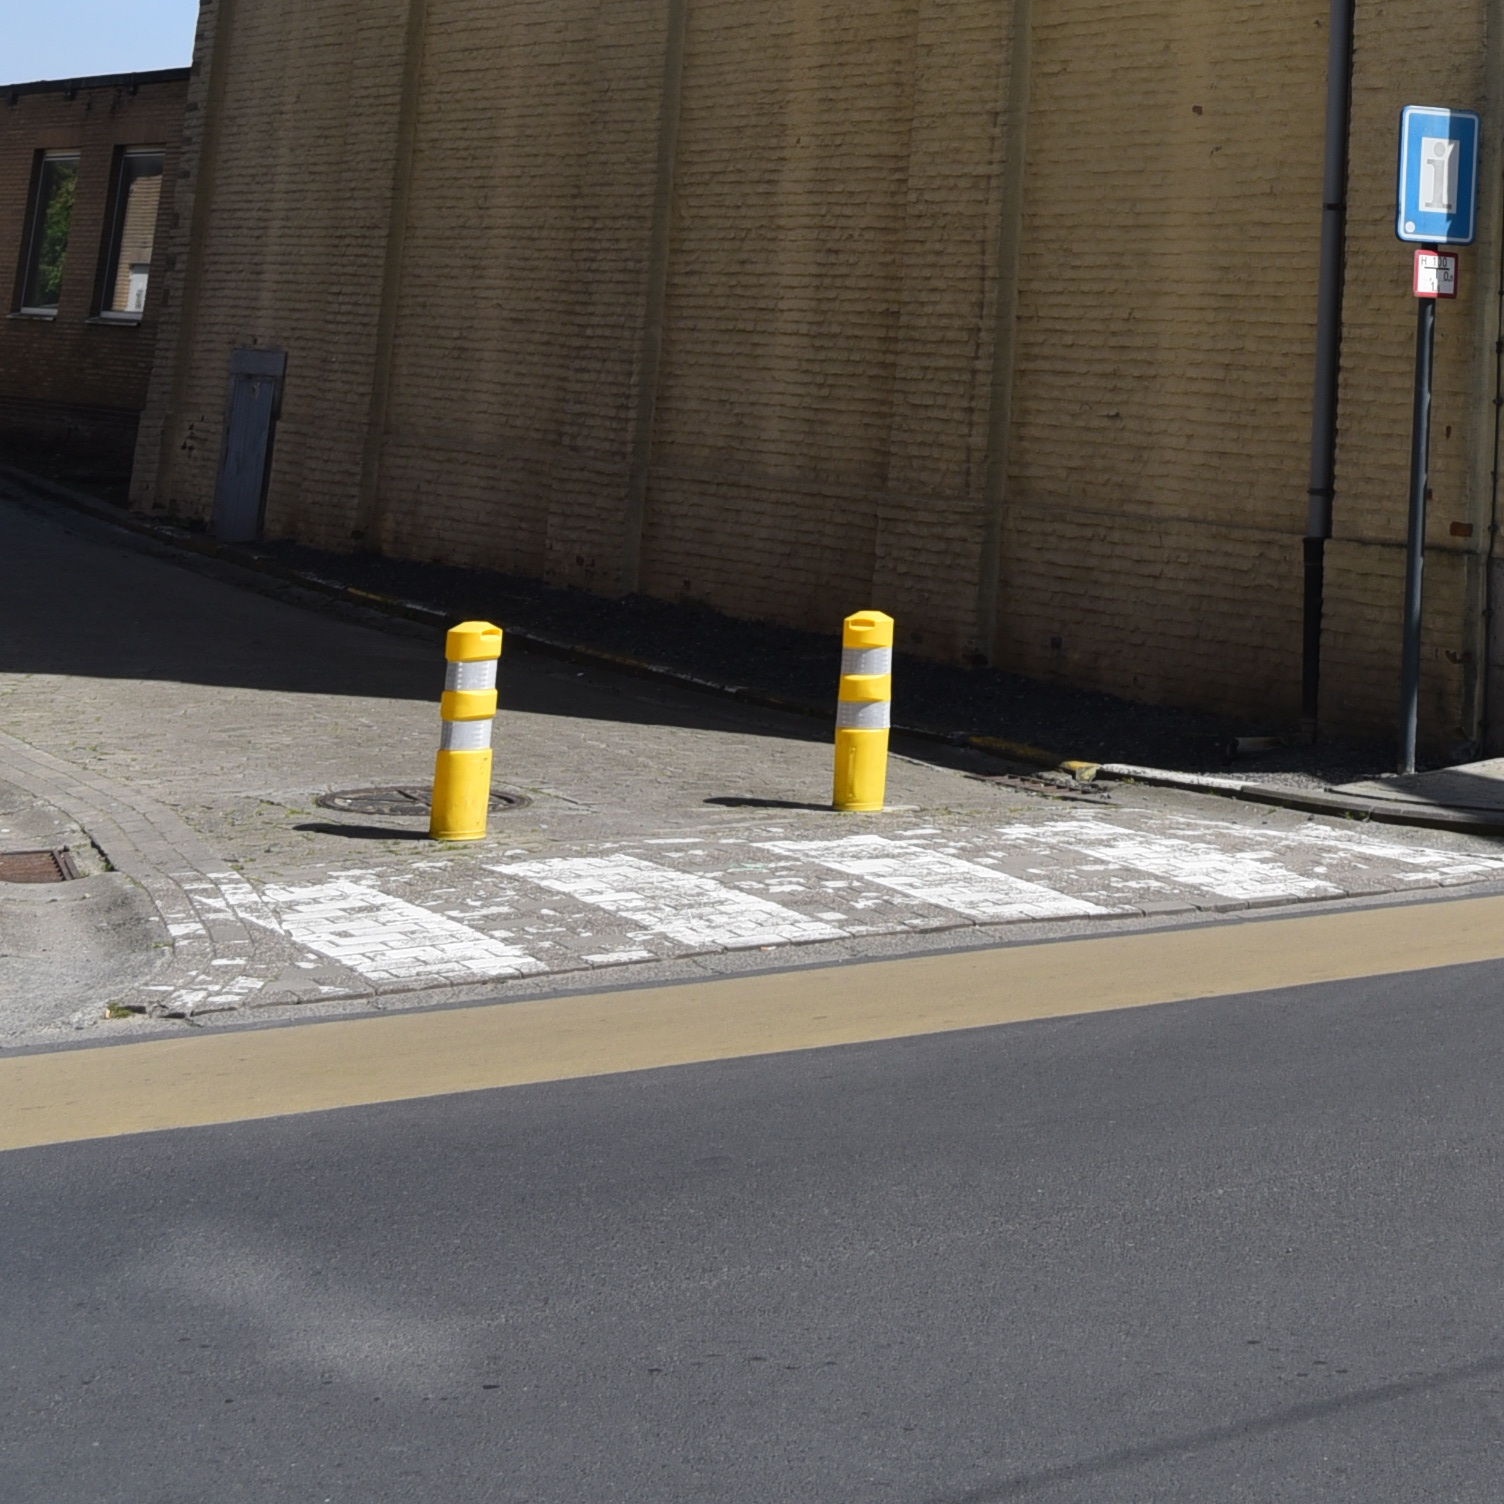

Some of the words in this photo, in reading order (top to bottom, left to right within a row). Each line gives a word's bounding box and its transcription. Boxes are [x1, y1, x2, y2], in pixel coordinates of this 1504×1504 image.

[1424, 141, 1453, 210] i
[1420, 255, 1428, 266] H
[1432, 256, 1448, 268] 100
